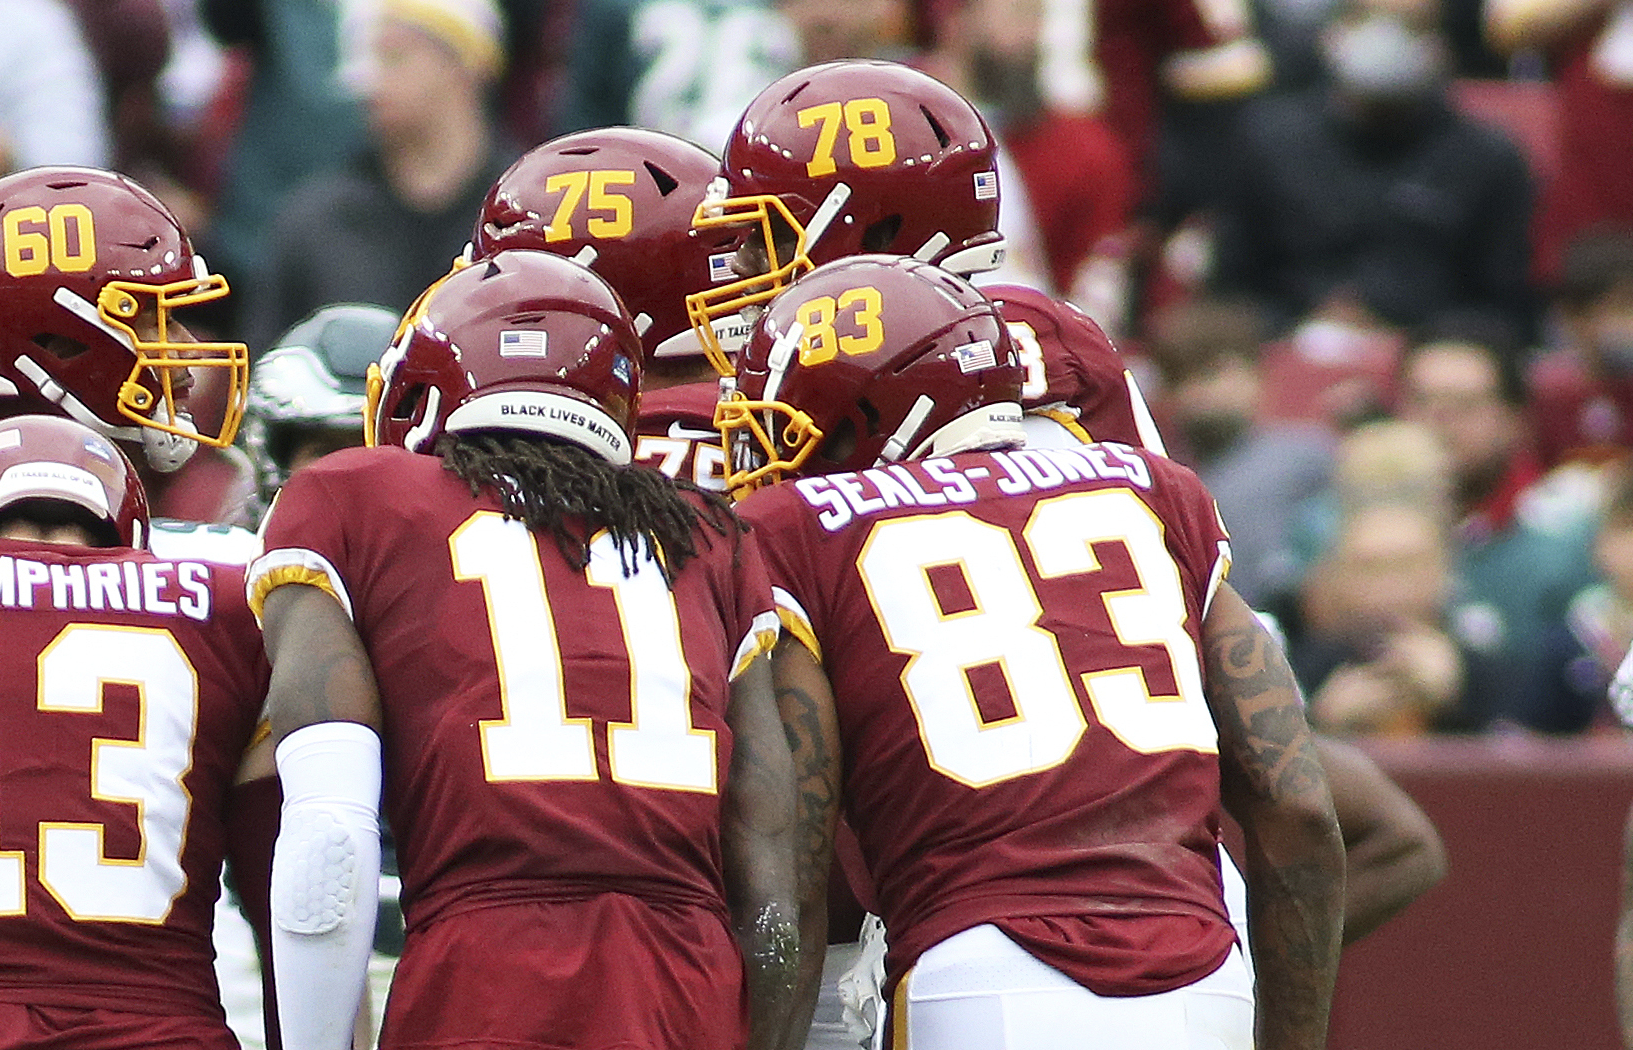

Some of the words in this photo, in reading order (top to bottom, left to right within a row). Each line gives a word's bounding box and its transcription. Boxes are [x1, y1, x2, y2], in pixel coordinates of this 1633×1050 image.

[797, 97, 897, 179] 78
[2, 204, 96, 277] 60
[545, 170, 636, 243] 75
[728, 324, 752, 338] TAKE
[795, 286, 884, 367] 83
[501, 404, 546, 417] BLACK
[550, 407, 586, 427] LIVES
[587, 420, 622, 452] MATTER
[10, 472, 18, 480] IT
[52, 472, 67, 480] ALL
[82, 478, 94, 487] US
[795, 441, 1153, 532] SEALS-JONES
[448, 510, 718, 795] 11
[855, 487, 1220, 790] 83
